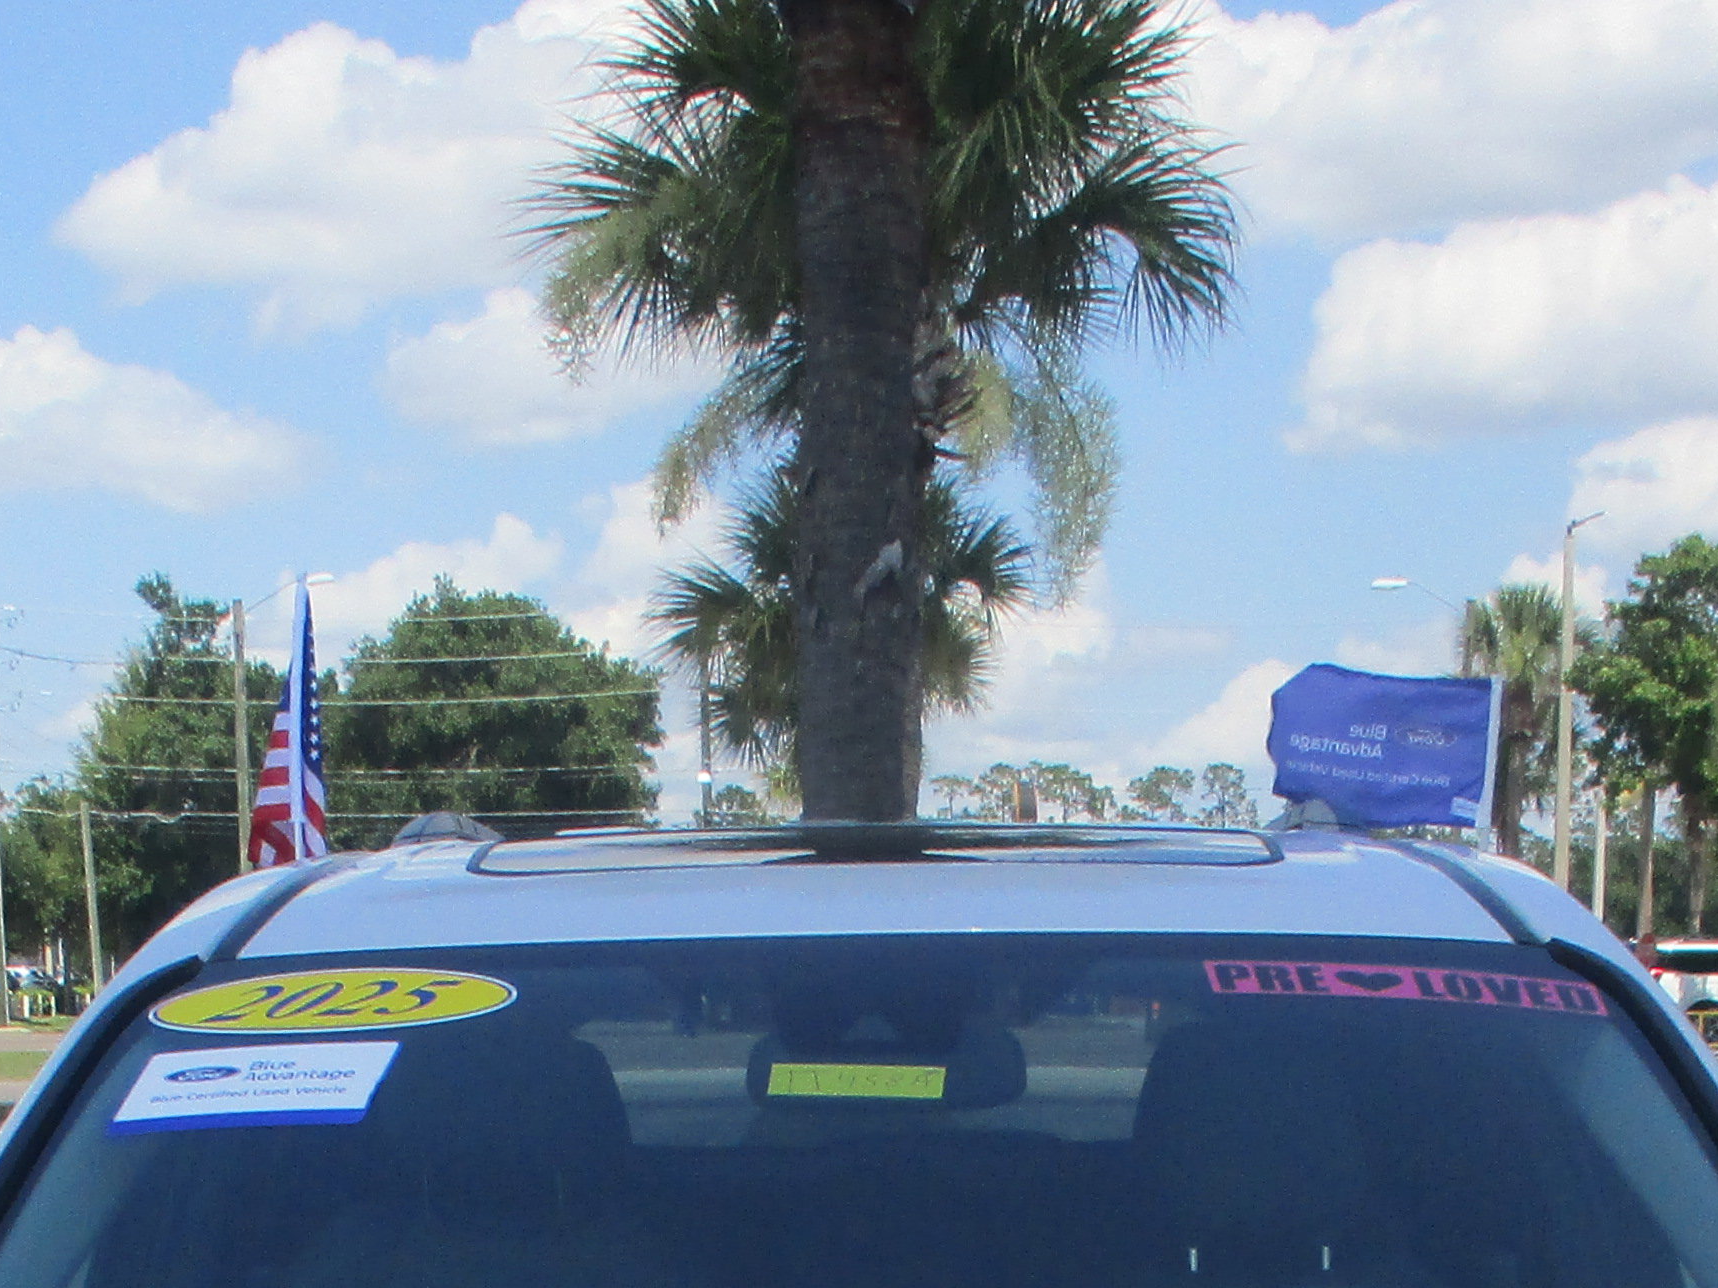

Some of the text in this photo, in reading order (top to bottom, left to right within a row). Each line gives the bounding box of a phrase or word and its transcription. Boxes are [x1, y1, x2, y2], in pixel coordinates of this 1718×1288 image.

[1213, 963, 1602, 1012] PRE LOVED
[197, 979, 463, 1023] 2025
[243, 1068, 356, 1082] Advantage
[247, 1060, 297, 1071] Blue
[149, 1085, 347, 1104] Blue Certified Used Vehicle
